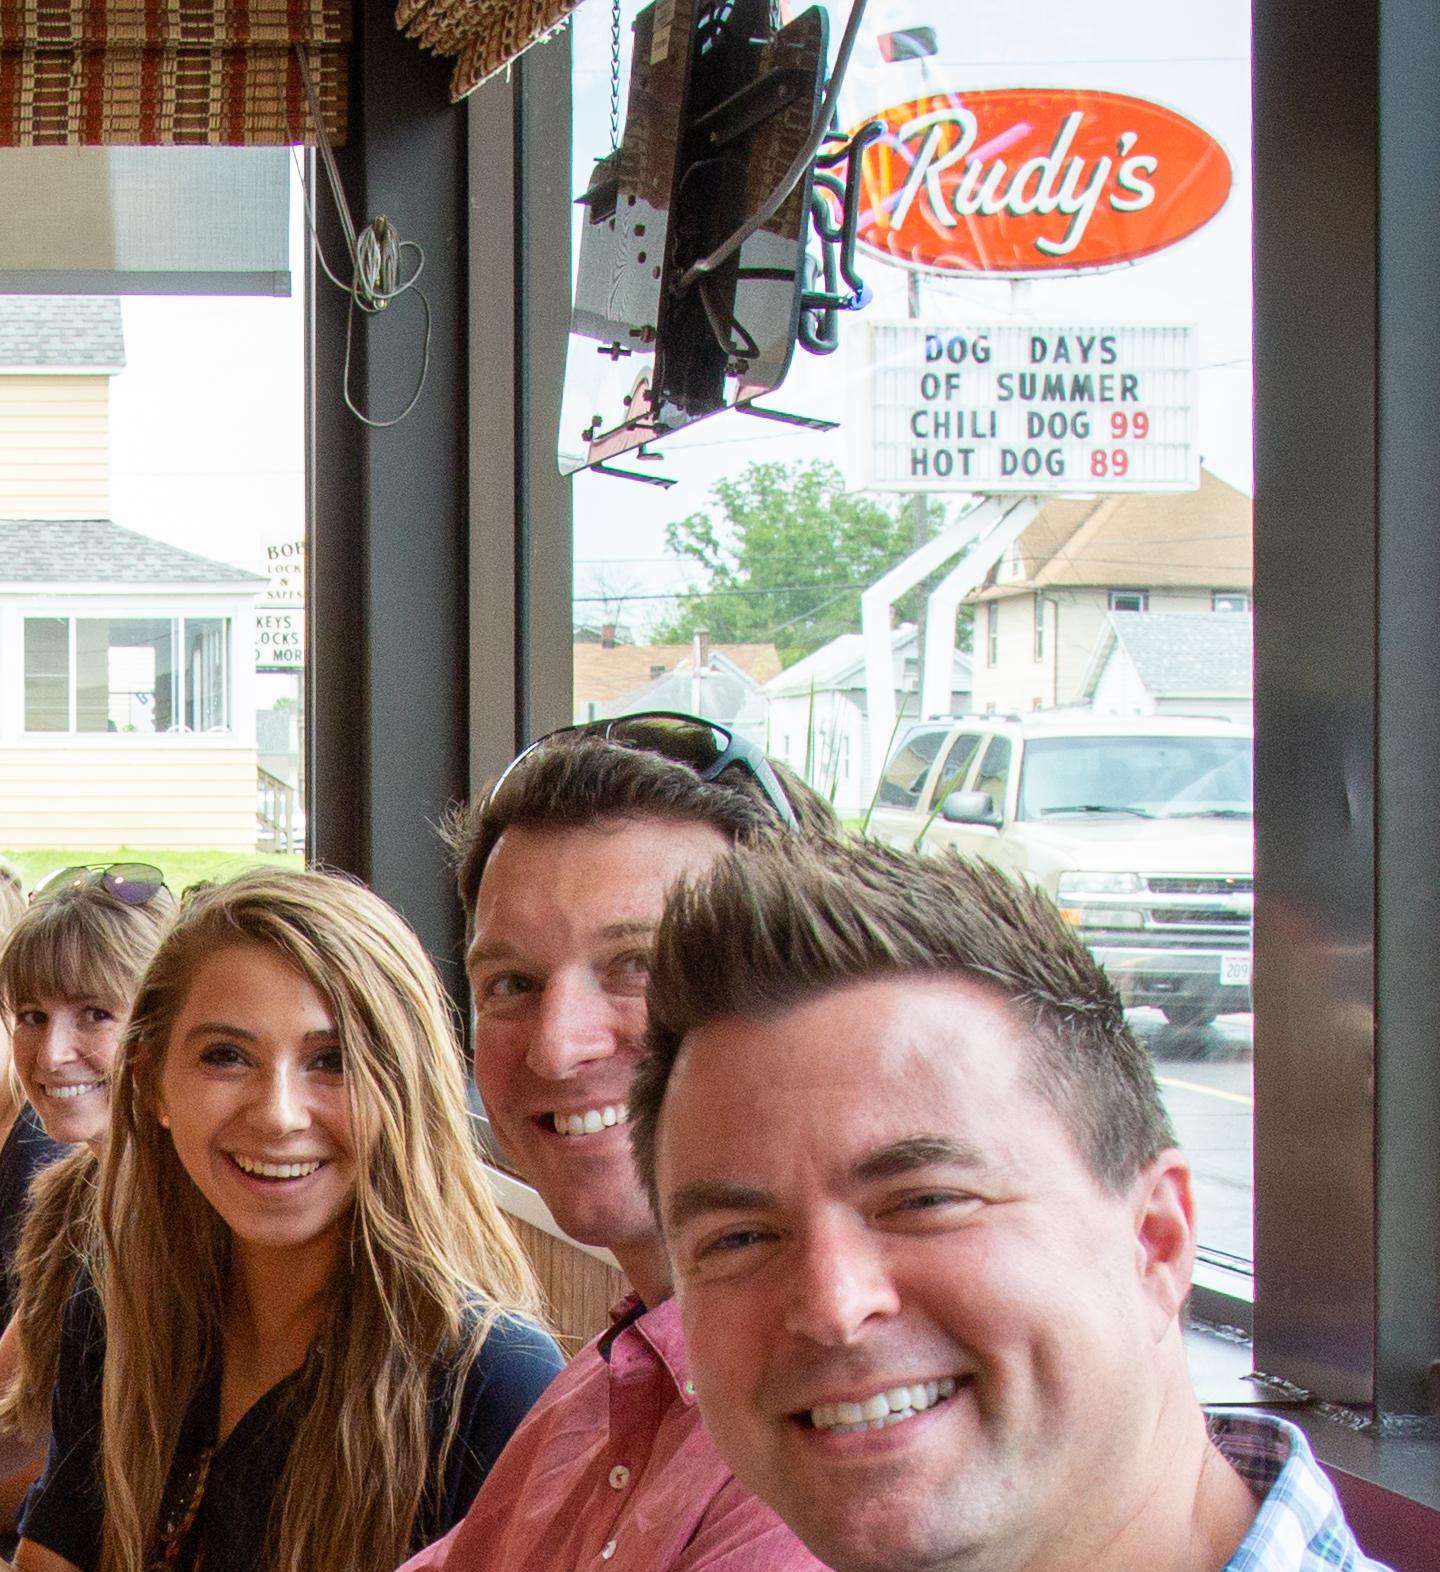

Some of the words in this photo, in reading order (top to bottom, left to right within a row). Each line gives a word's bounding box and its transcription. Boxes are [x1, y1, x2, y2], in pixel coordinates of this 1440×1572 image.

[890, 109, 1158, 257] Rudy's
[925, 336, 990, 364] DOG
[1031, 336, 1117, 364] DAYS
[921, 374, 961, 401] OF
[997, 373, 1139, 402] SUMMER
[911, 411, 998, 439] CHILI
[1027, 411, 1090, 438] DOG
[1111, 411, 1149, 439] 99
[910, 449, 974, 477] HOT
[1001, 449, 1065, 477] DOG
[1090, 449, 1129, 477] 89
[256, 616, 291, 628] KEYS
[255, 632, 298, 645] OCKS
[273, 649, 303, 661] MOR
